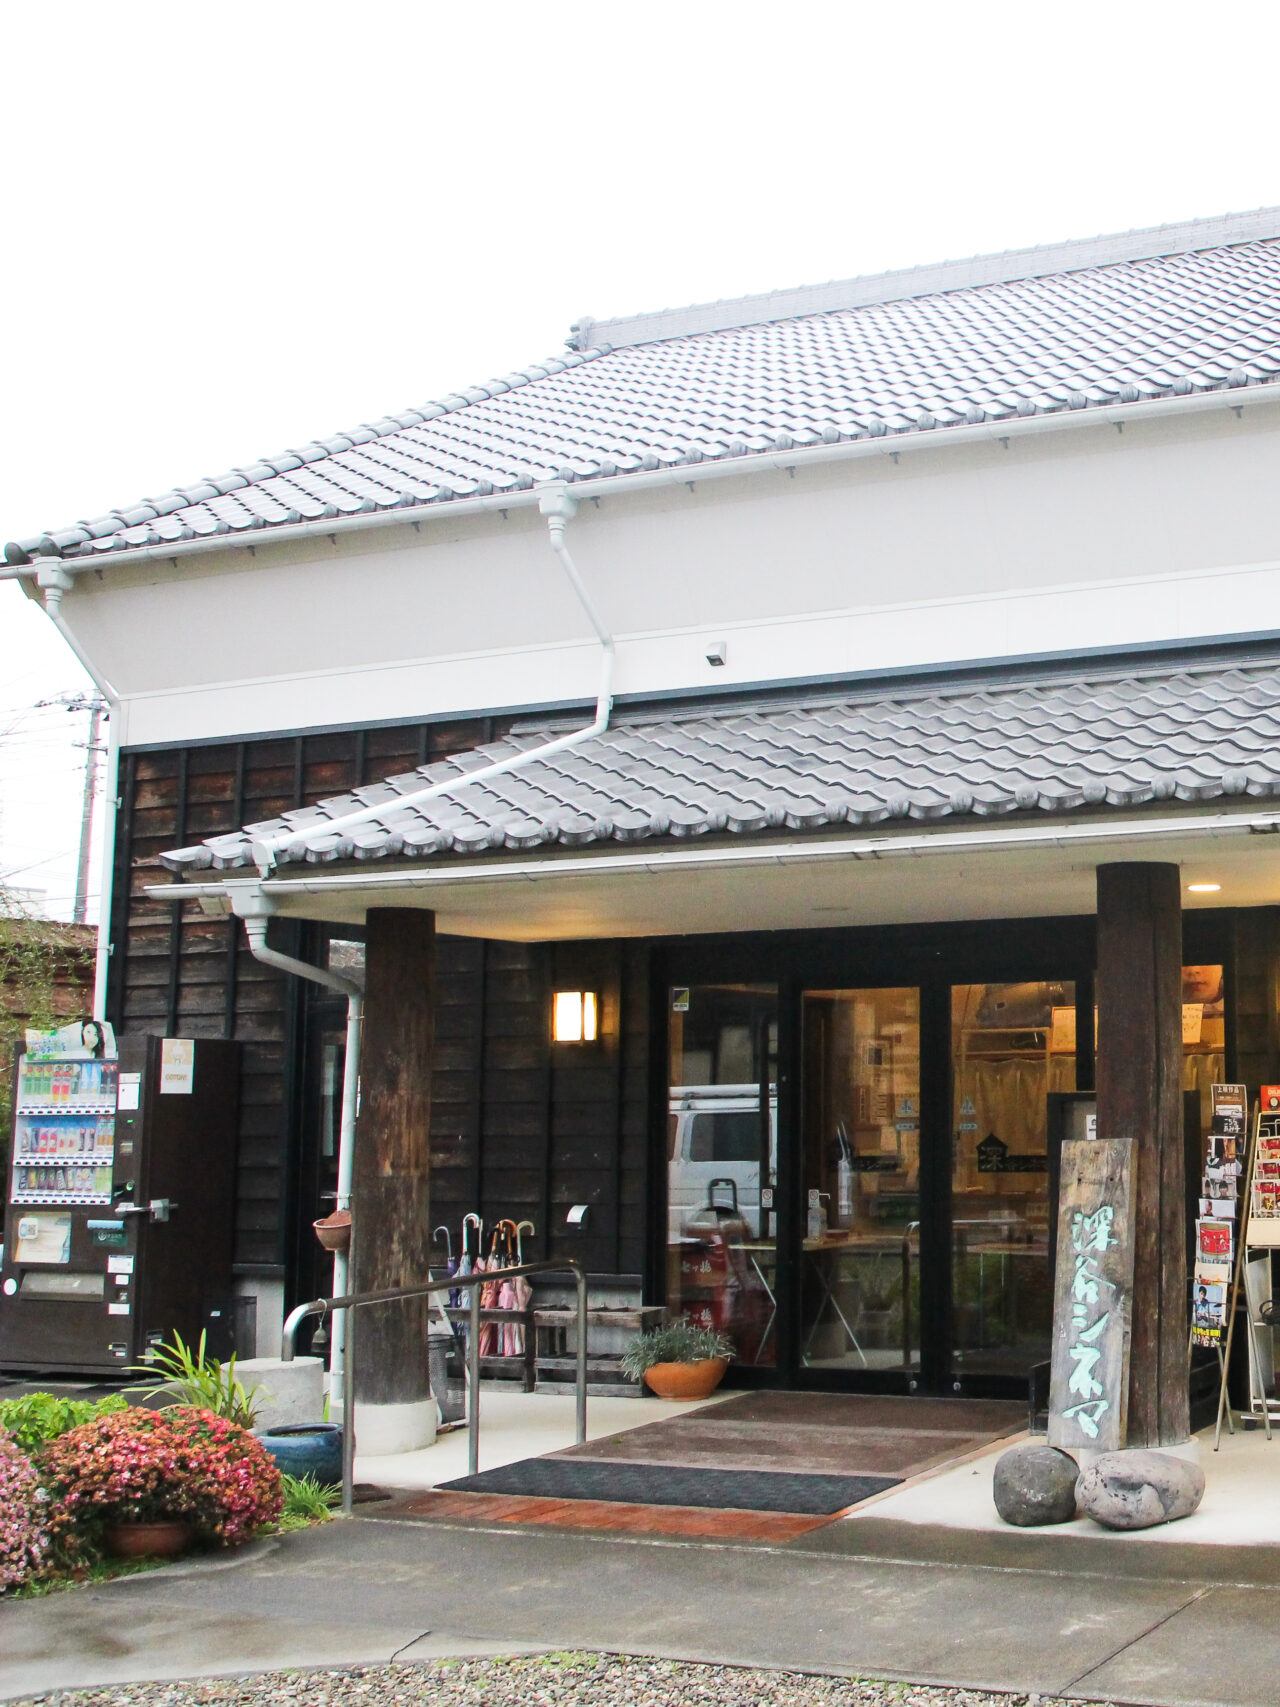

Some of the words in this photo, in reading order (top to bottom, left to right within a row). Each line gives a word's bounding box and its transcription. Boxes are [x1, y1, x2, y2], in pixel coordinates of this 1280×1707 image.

[1062, 1205, 1118, 1439] 深谷シネマ
